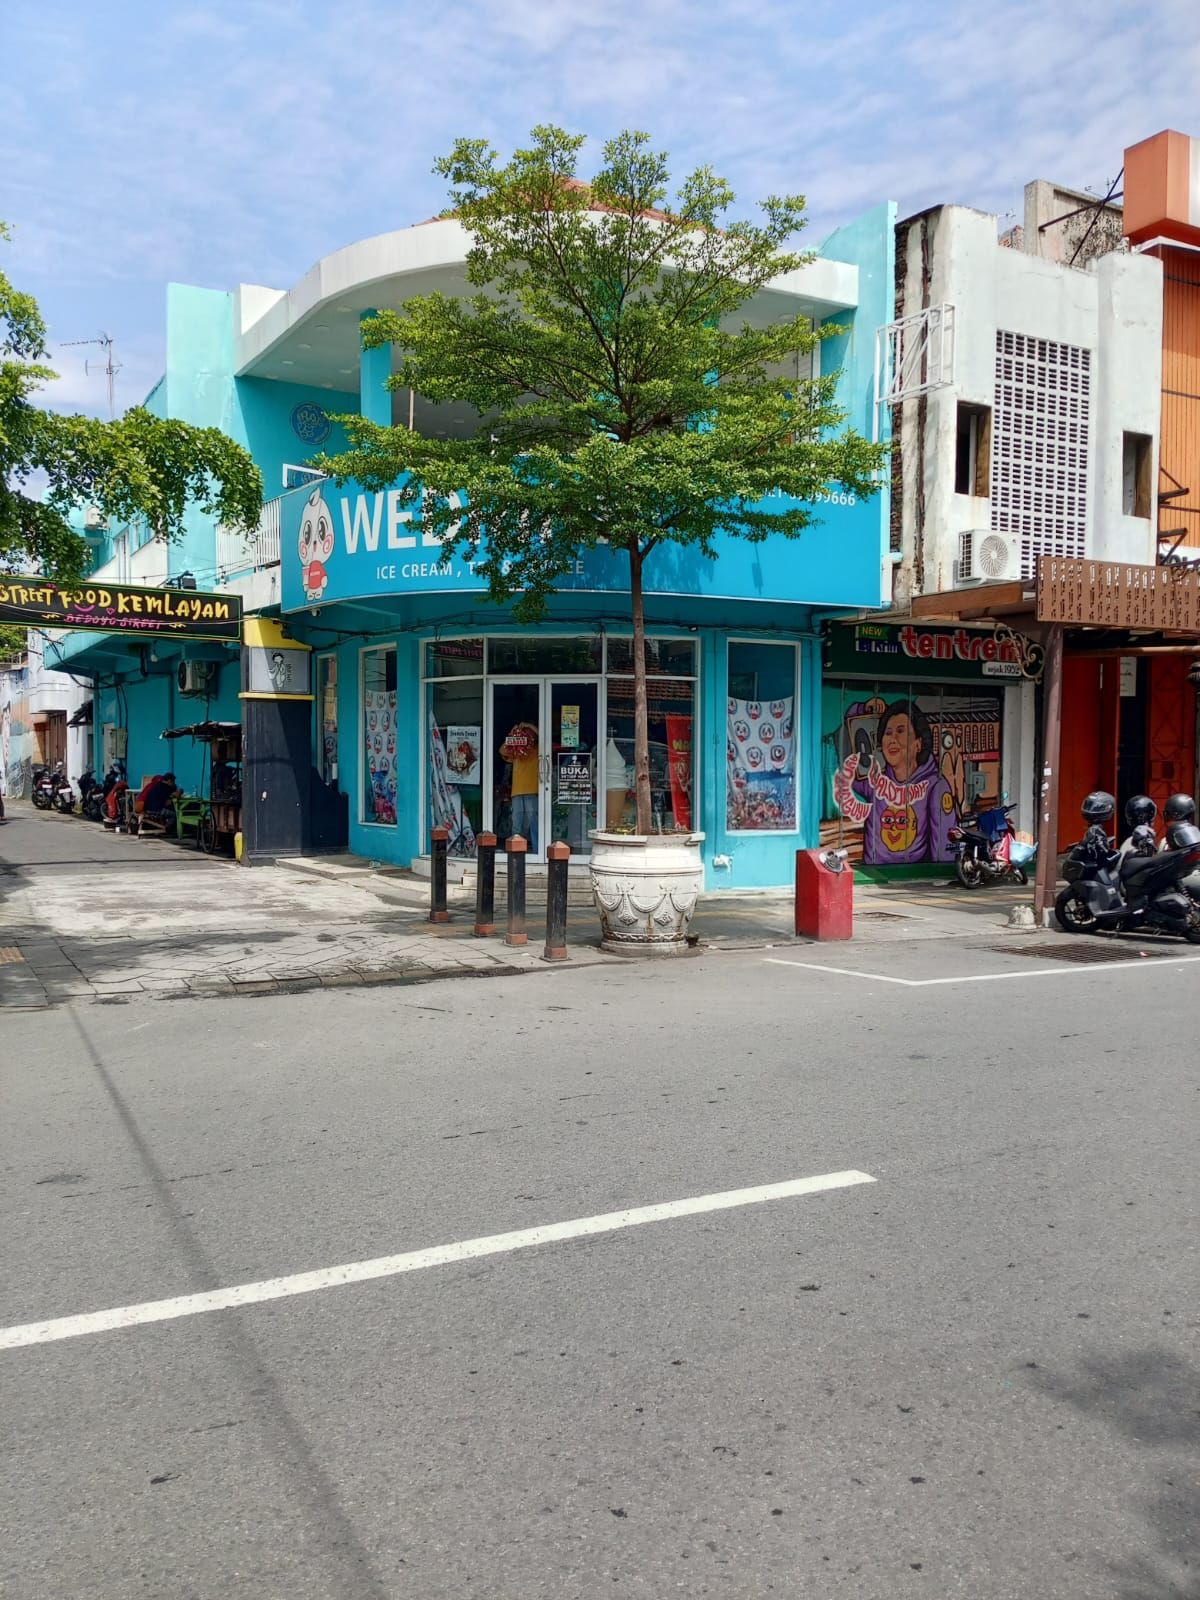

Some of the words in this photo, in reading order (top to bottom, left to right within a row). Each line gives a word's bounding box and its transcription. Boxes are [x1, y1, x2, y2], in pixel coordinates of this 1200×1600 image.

[376, 565, 396, 580] ICE
[401, 562, 453, 578] CREAM
[58, 590, 112, 609] FOOD
[117, 593, 229, 620] KEMLAYAN
[863, 626, 882, 637] NEW
[900, 625, 1023, 662] tentrem
[560, 767, 589, 775] BUKA
